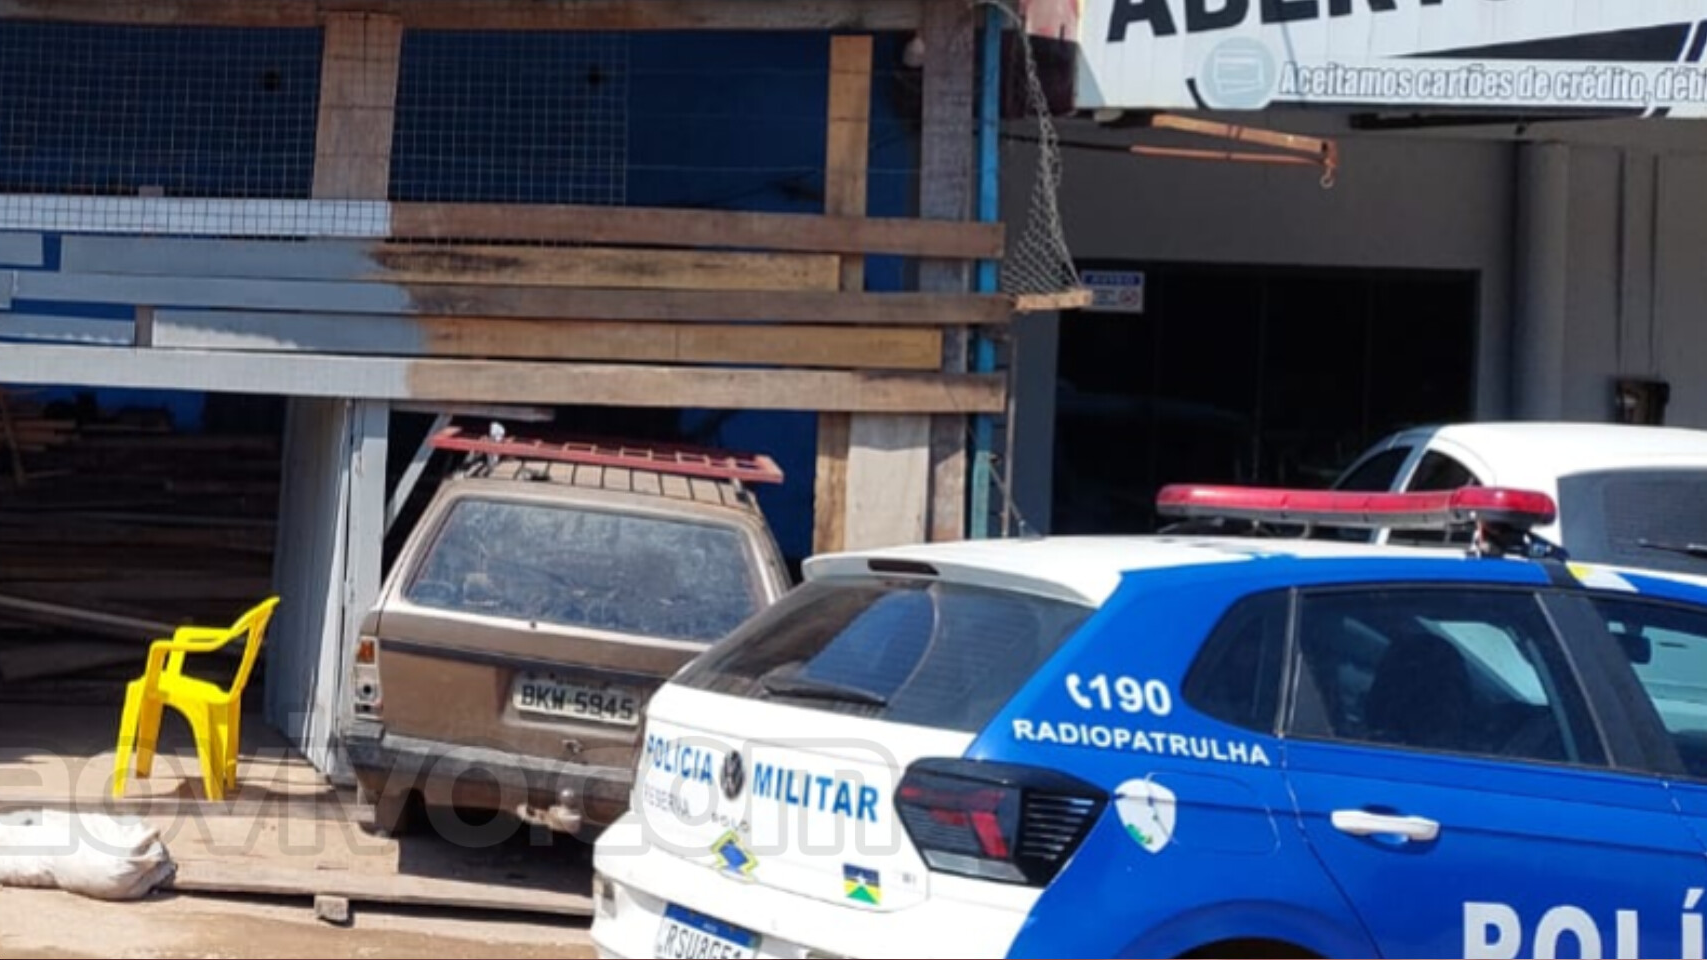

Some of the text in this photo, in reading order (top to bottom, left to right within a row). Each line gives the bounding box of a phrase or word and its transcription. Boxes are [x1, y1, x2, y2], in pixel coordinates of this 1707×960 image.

[1279, 62, 1413, 98] Aceitamos
[1415, 63, 1513, 99] cartões
[1515, 66, 1552, 99] de
[1654, 65, 1707, 101] déb
[1089, 674, 1172, 716] 190
[1012, 719, 1271, 767] RADIOPATRULHA
[752, 762, 880, 824] MILITAR
